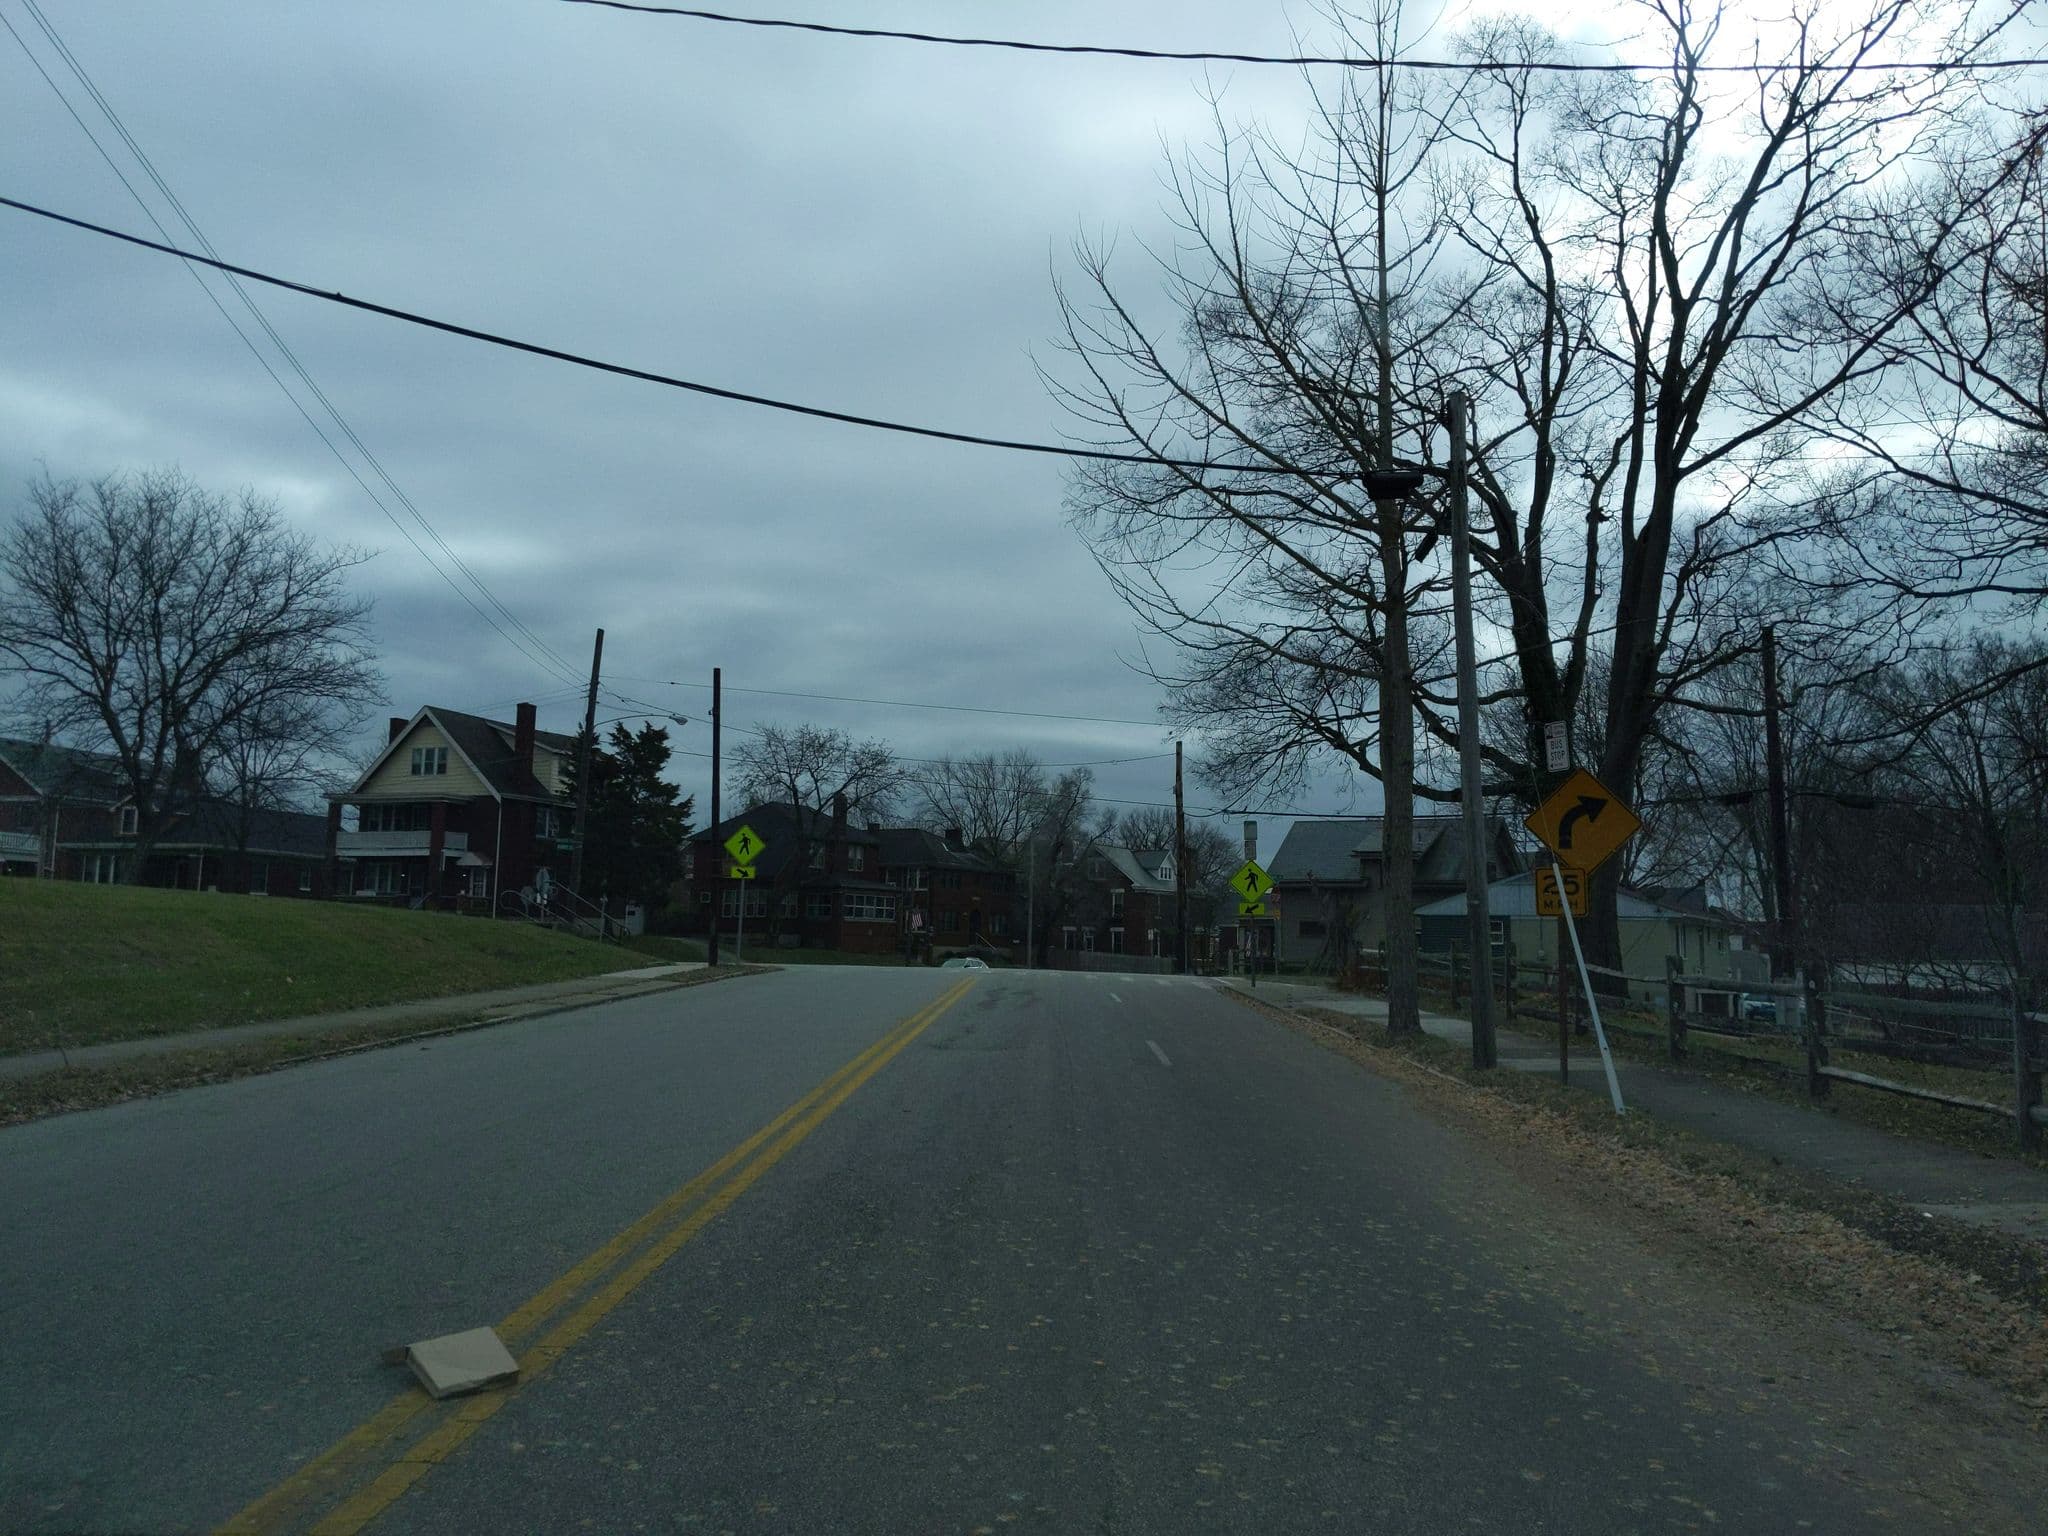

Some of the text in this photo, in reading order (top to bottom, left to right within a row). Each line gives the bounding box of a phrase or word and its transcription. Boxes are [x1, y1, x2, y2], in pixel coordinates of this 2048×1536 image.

[1551, 739, 1562, 750] BUS
[1551, 750, 1565, 761] STOP
[1543, 875, 1579, 896] 25
